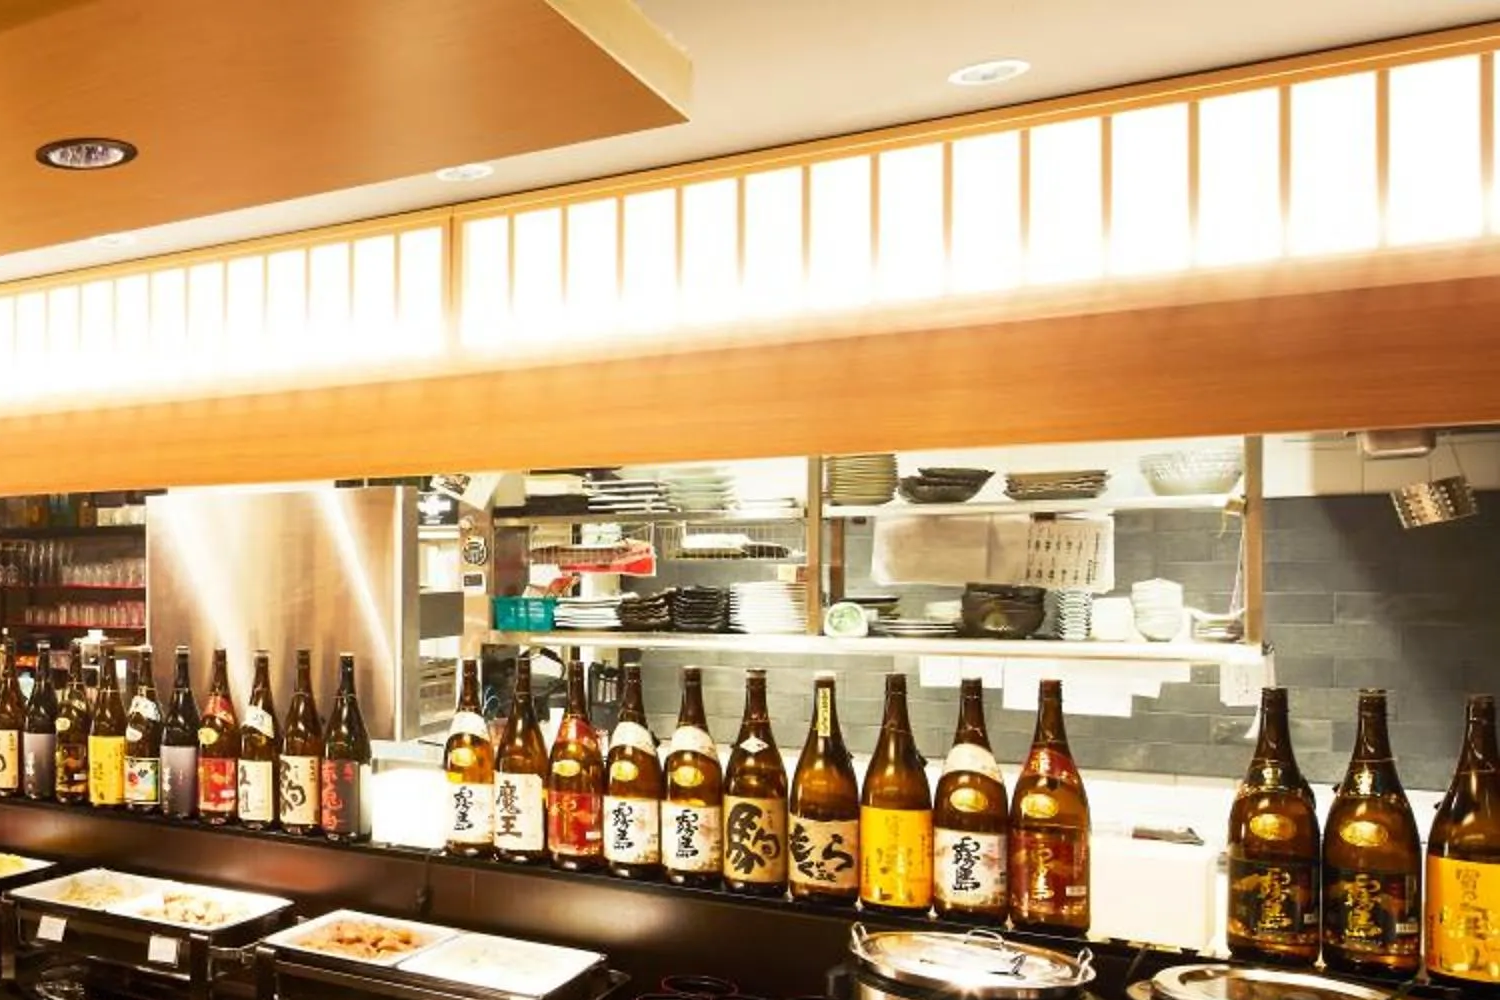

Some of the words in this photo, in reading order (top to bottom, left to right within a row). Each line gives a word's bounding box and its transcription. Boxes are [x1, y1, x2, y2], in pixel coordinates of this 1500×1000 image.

[496, 780, 522, 838] 魔王
[612, 802, 634, 850] 霧島
[676, 809, 699, 858] 霧島
[952, 836, 981, 891] 霧島
